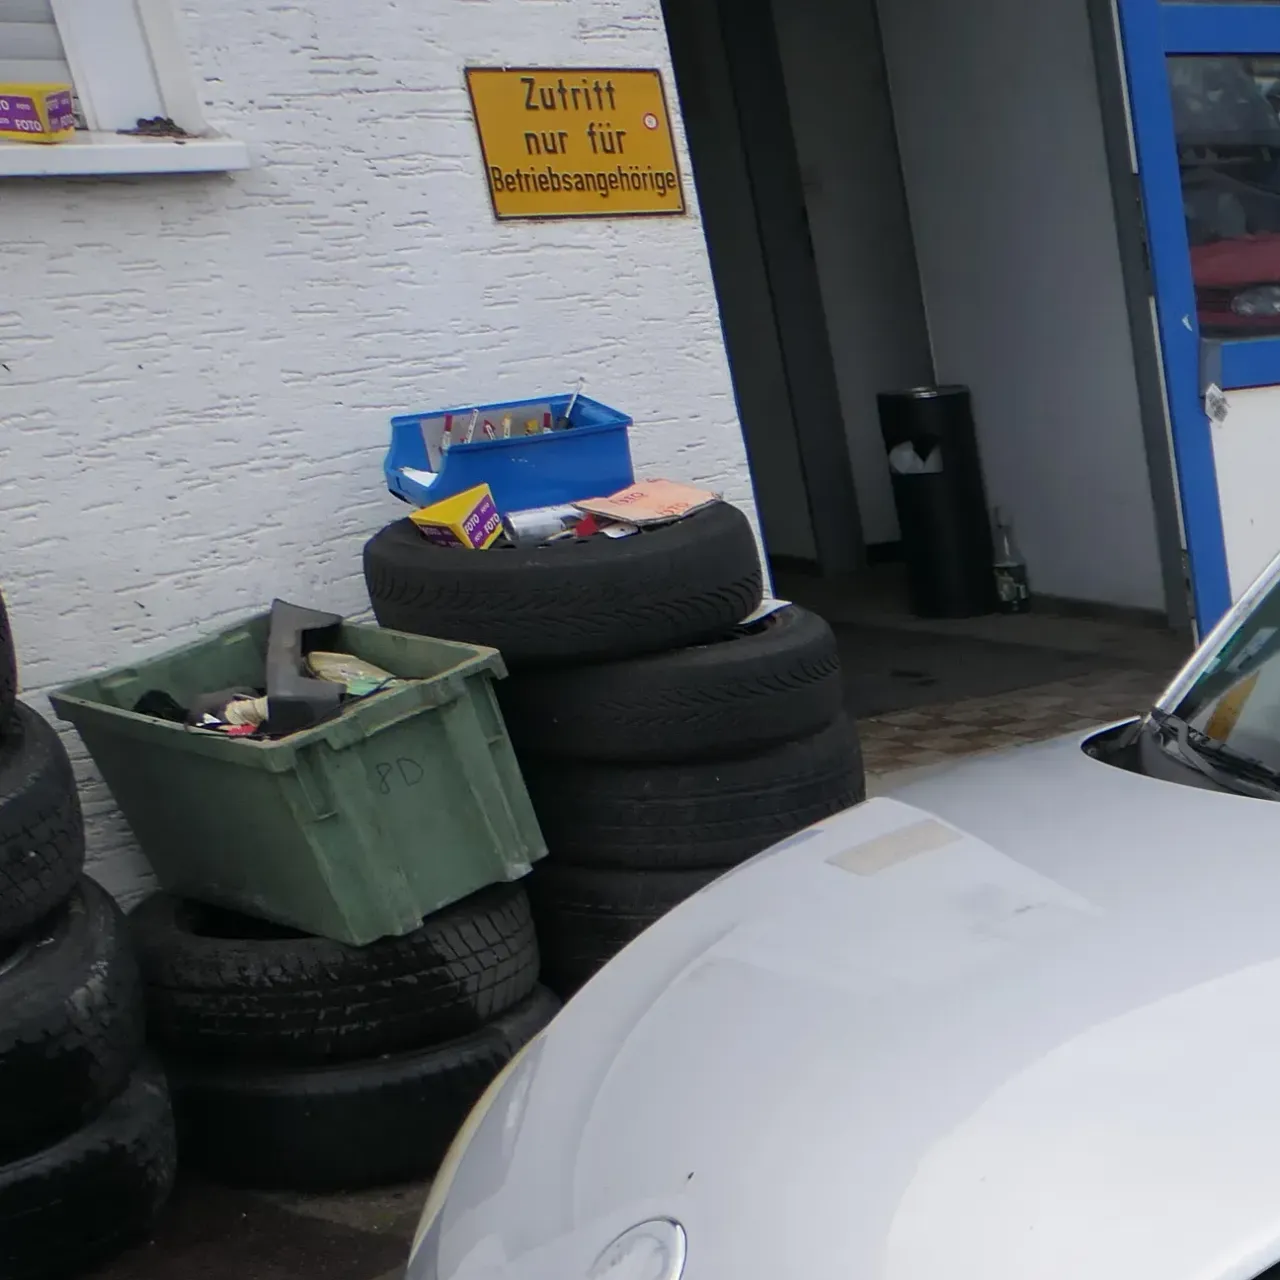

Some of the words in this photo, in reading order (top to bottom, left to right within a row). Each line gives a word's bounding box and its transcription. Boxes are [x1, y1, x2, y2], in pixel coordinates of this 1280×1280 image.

[520, 77, 616, 111] Zutritt
[15, 119, 42, 132] FOTO
[524, 131, 569, 155] nur
[587, 122, 628, 154] für
[491, 166, 676, 197] Betriebsangehörige
[464, 514, 480, 535] FOTO
[484, 513, 500, 534] FOTO
